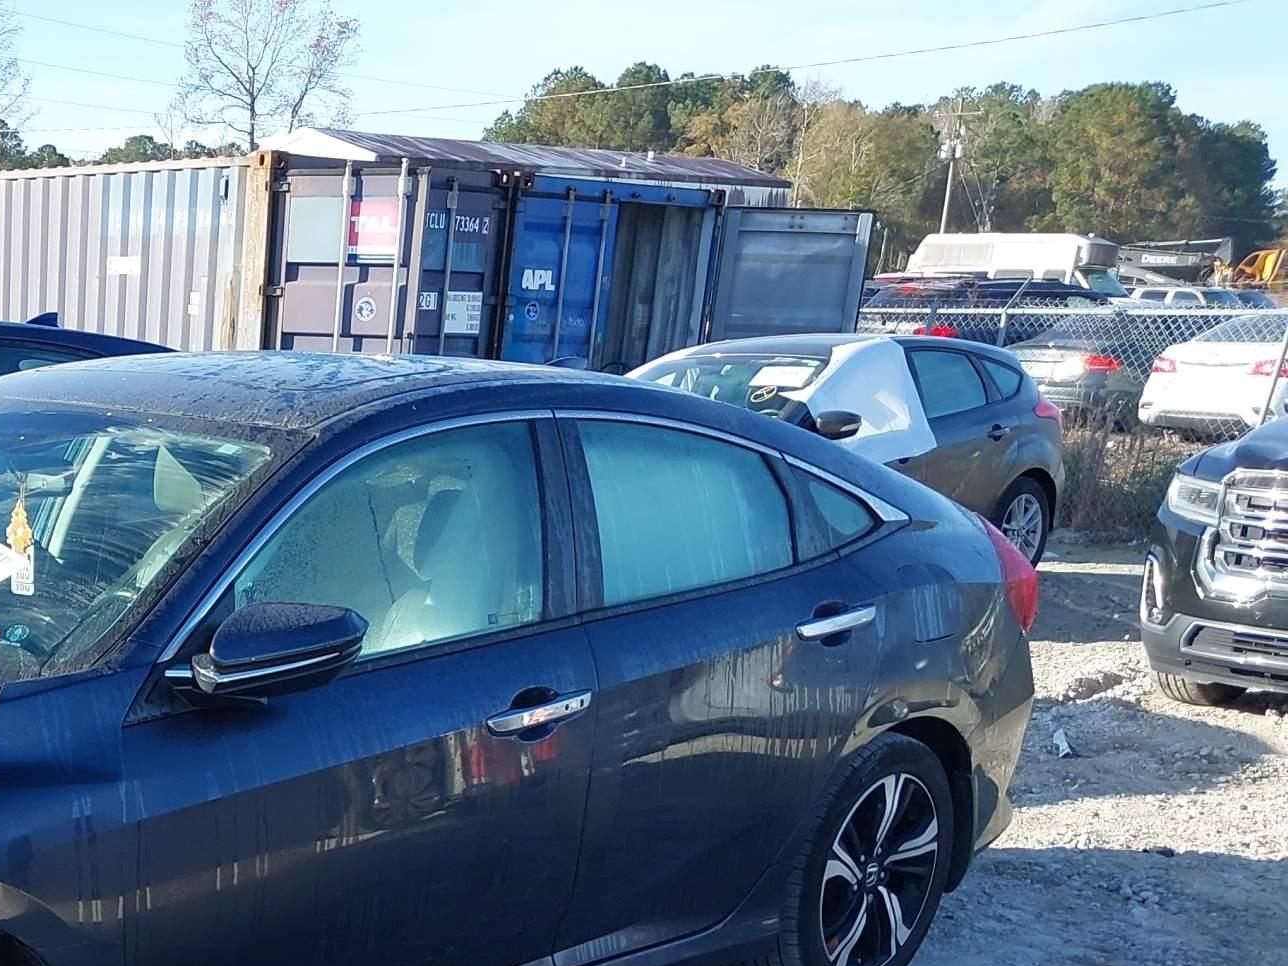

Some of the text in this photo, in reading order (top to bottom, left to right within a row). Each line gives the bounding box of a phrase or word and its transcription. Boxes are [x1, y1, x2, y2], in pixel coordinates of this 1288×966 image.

[350, 216, 397, 233] TAL
[1142, 254, 1178, 264] DEERE
[521, 269, 556, 291] APL
